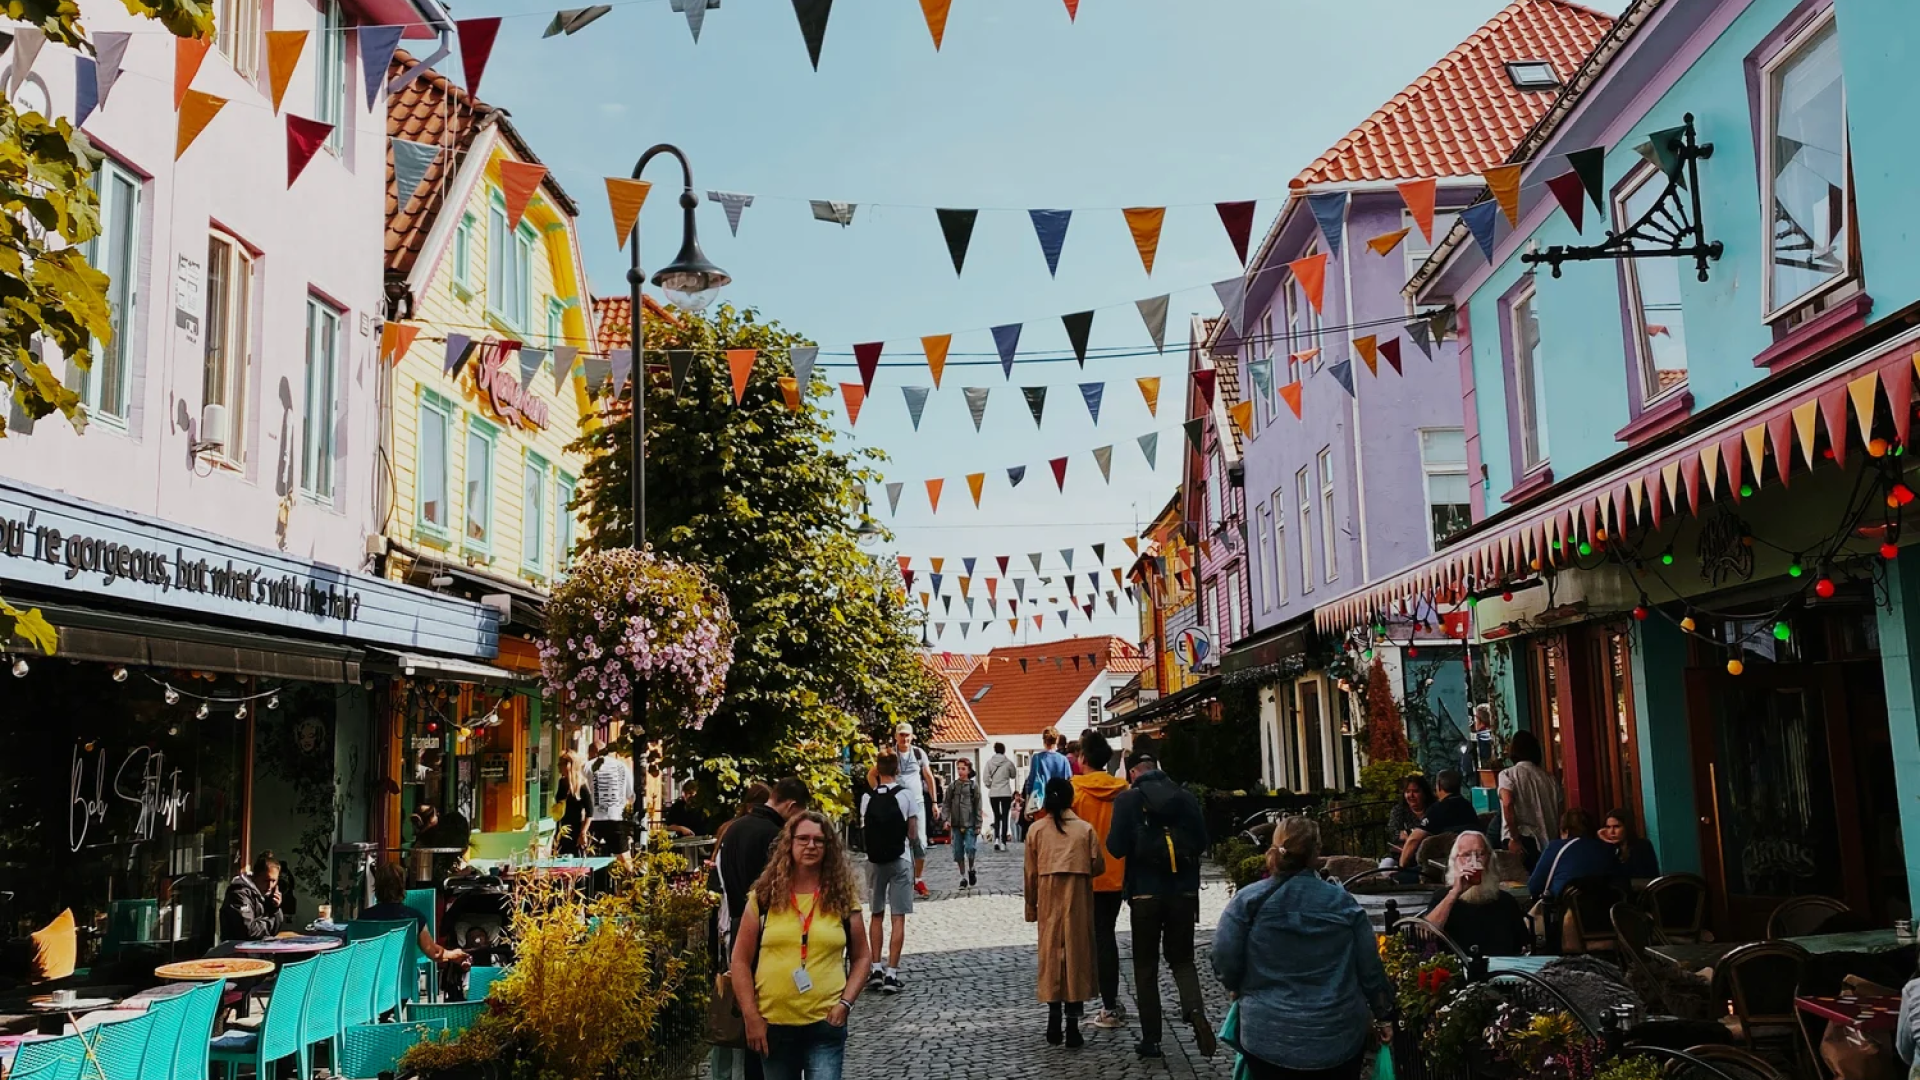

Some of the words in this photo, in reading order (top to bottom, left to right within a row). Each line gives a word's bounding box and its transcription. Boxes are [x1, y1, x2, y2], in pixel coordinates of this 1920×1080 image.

[65, 534, 171, 593] gorgeous,
[175, 547, 210, 594] but
[210, 560, 267, 604] what's
[268, 575, 303, 612] with
[304, 579, 327, 616] the
[328, 584, 361, 621] hair?
